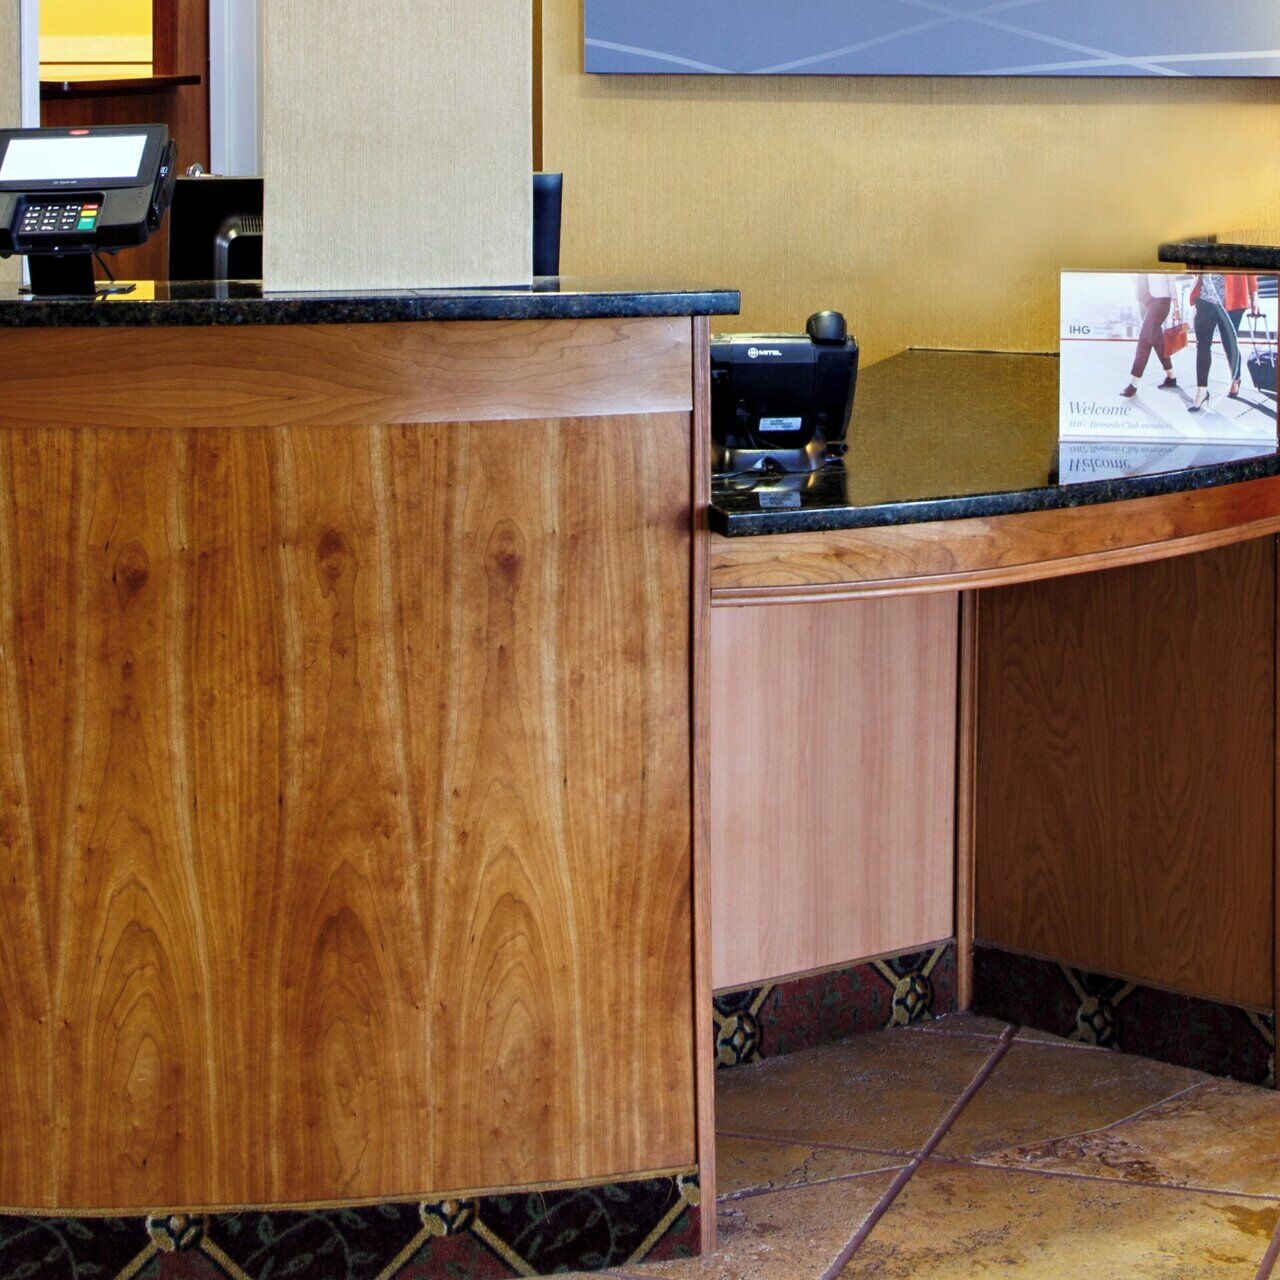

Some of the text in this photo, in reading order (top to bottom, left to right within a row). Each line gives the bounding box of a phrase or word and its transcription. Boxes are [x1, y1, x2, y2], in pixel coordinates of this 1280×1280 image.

[1069, 325, 1091, 334] IHG
[1070, 401, 1131, 416] Welcome
[1122, 420, 1139, 429] Club
